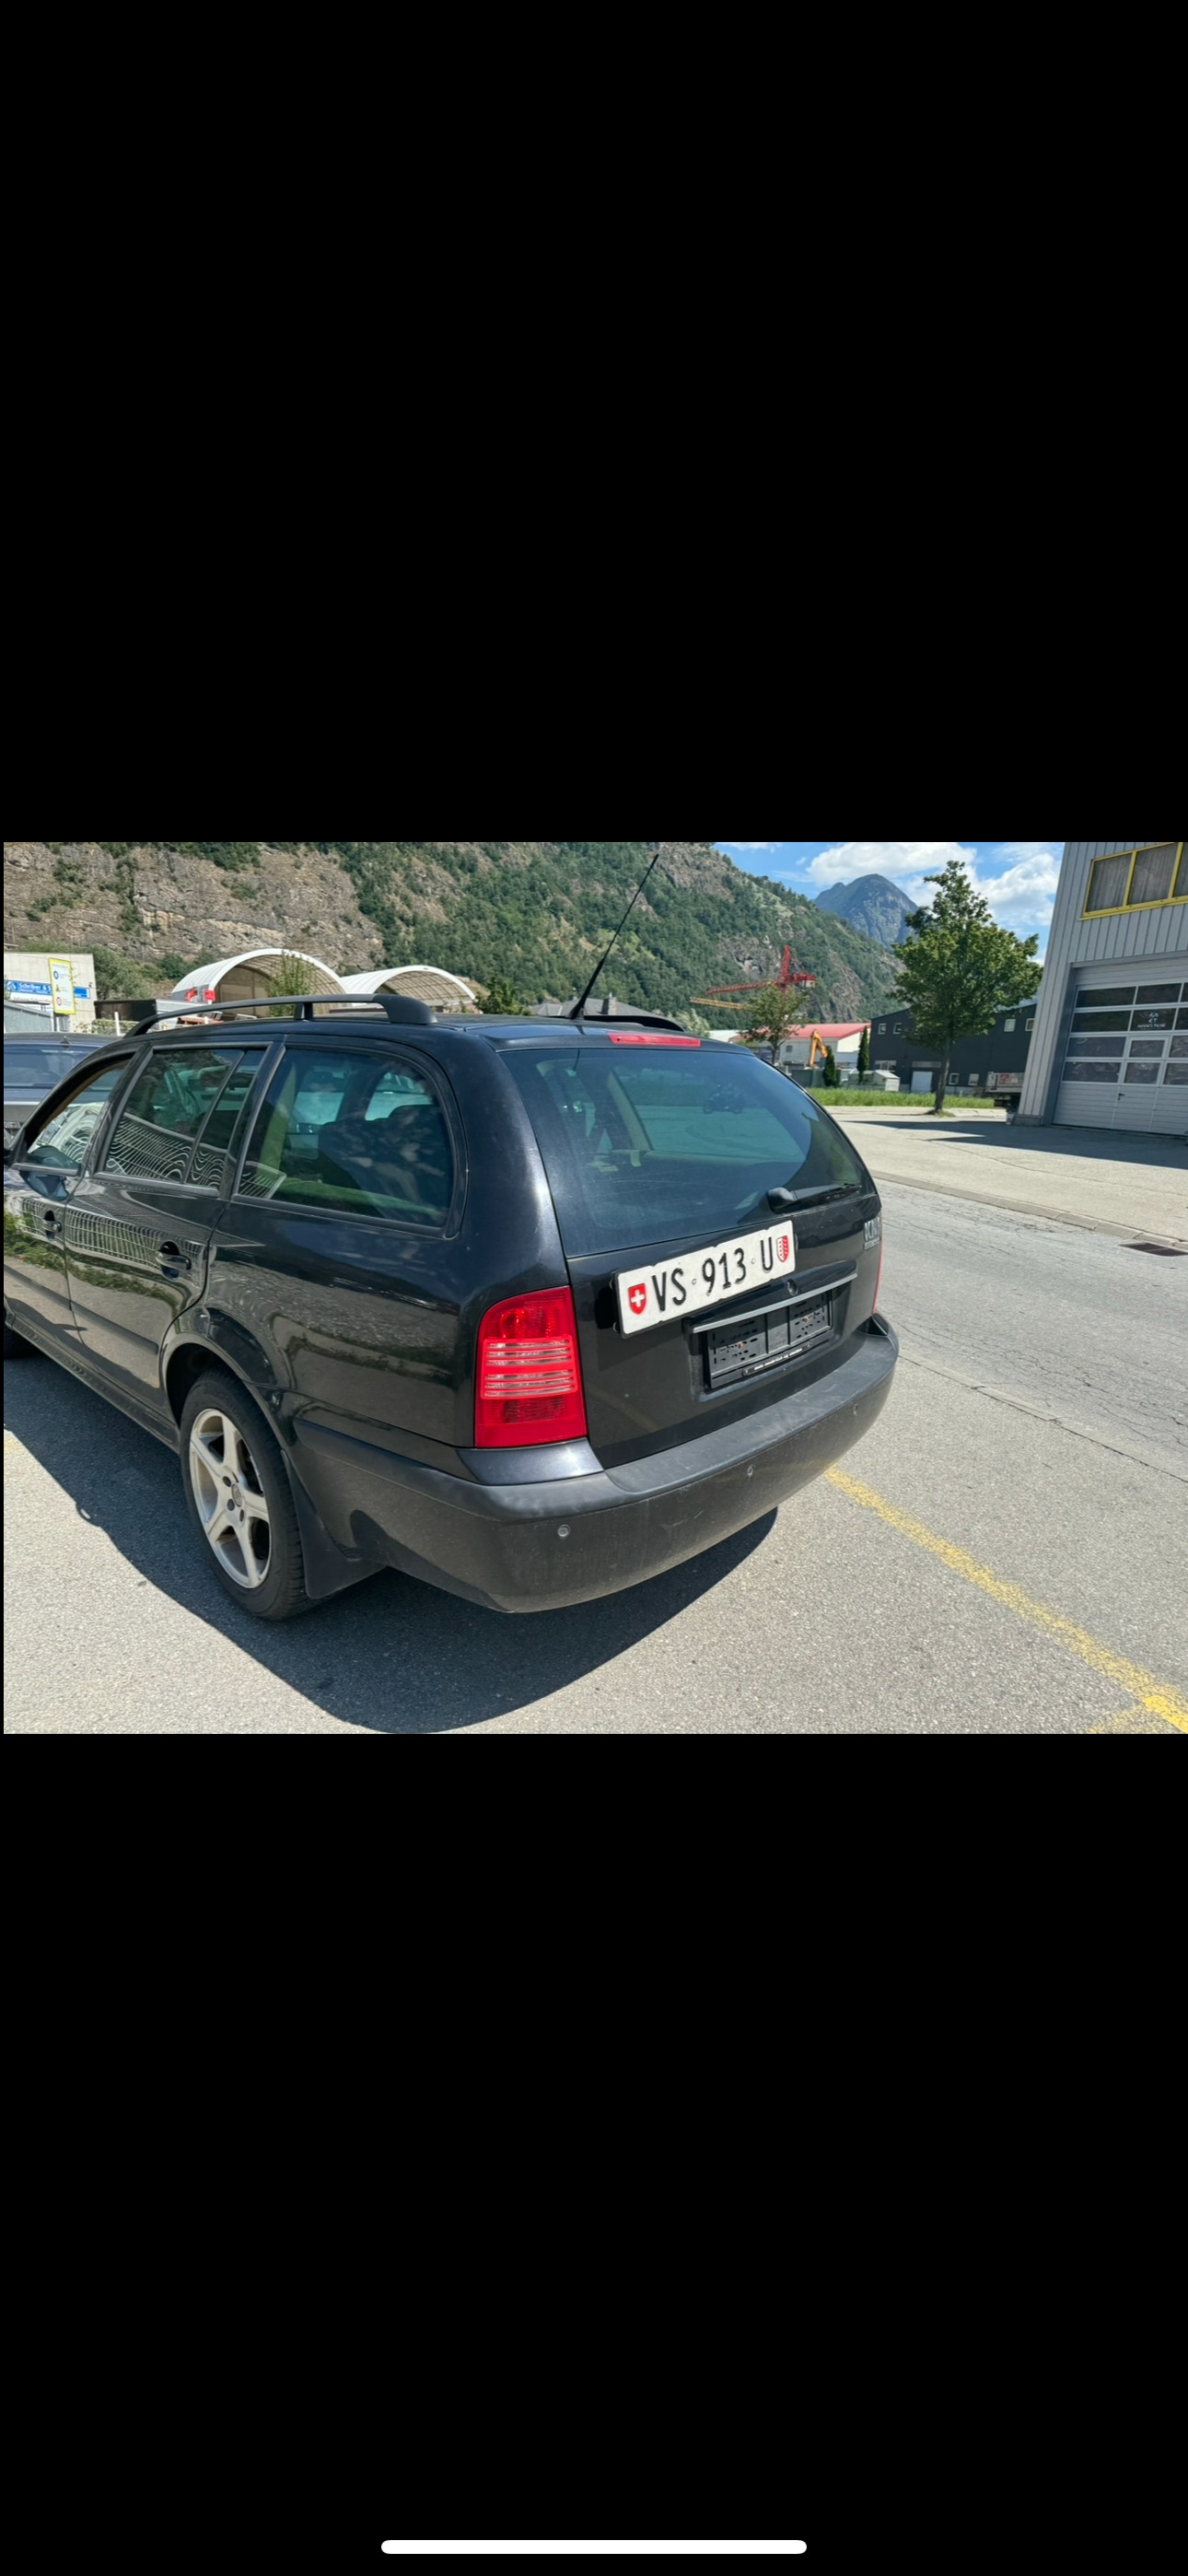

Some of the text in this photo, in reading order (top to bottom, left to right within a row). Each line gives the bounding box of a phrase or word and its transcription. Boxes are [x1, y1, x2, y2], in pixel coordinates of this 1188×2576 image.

[651, 1236, 774, 1312] VS 913 U
